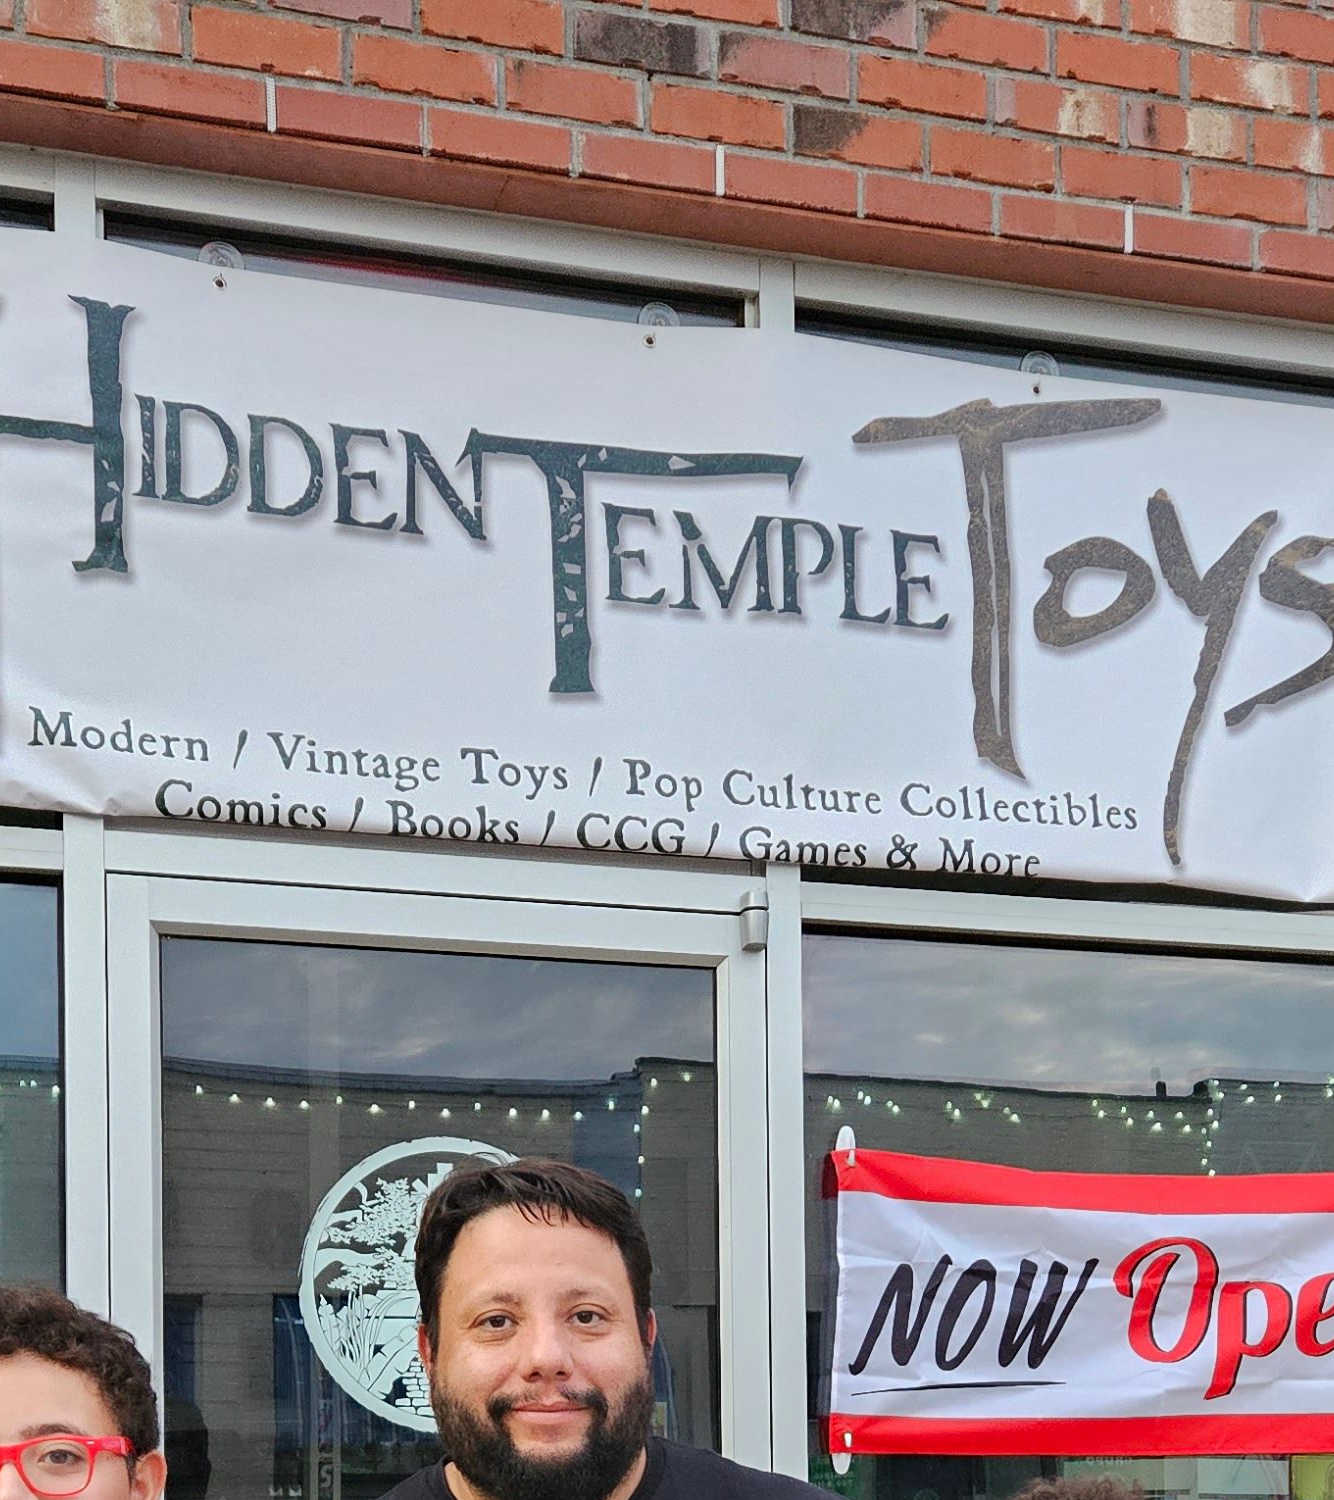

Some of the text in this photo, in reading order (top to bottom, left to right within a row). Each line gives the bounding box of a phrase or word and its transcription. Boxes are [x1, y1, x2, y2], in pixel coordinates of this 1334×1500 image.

[27, 705, 1140, 832] Modern / Vintage Toys / Pop Culture Collectibles
[154, 777, 1041, 878] Comics / Books / CCG / Games & More
[849, 1252, 1099, 1376] NOW
